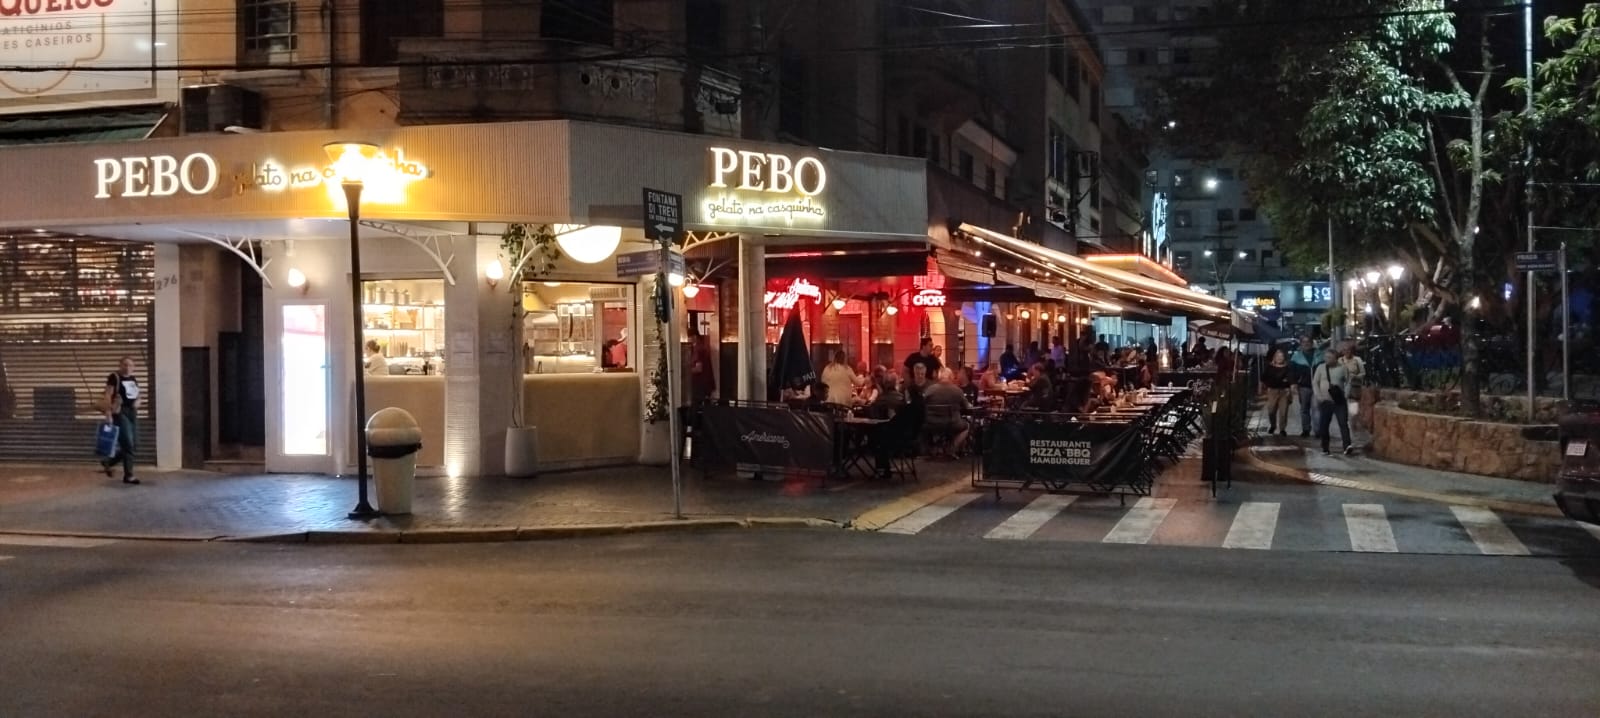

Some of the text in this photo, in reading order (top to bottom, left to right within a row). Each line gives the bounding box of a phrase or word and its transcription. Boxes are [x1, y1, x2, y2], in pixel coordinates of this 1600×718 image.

[25, 33, 93, 48] CASEIROS
[93, 153, 217, 198] PEBO
[290, 169, 316, 184] na
[708, 146, 826, 196] PEBO
[648, 191, 677, 206] FONTANA
[658, 204, 677, 218] TREVI
[708, 198, 825, 220] gelato na casquinha
[1030, 440, 1091, 449] RESTAURANTE
[1030, 447, 1091, 458] PIZZA BBQ
[1030, 456, 1090, 466] HAMBURGUER
